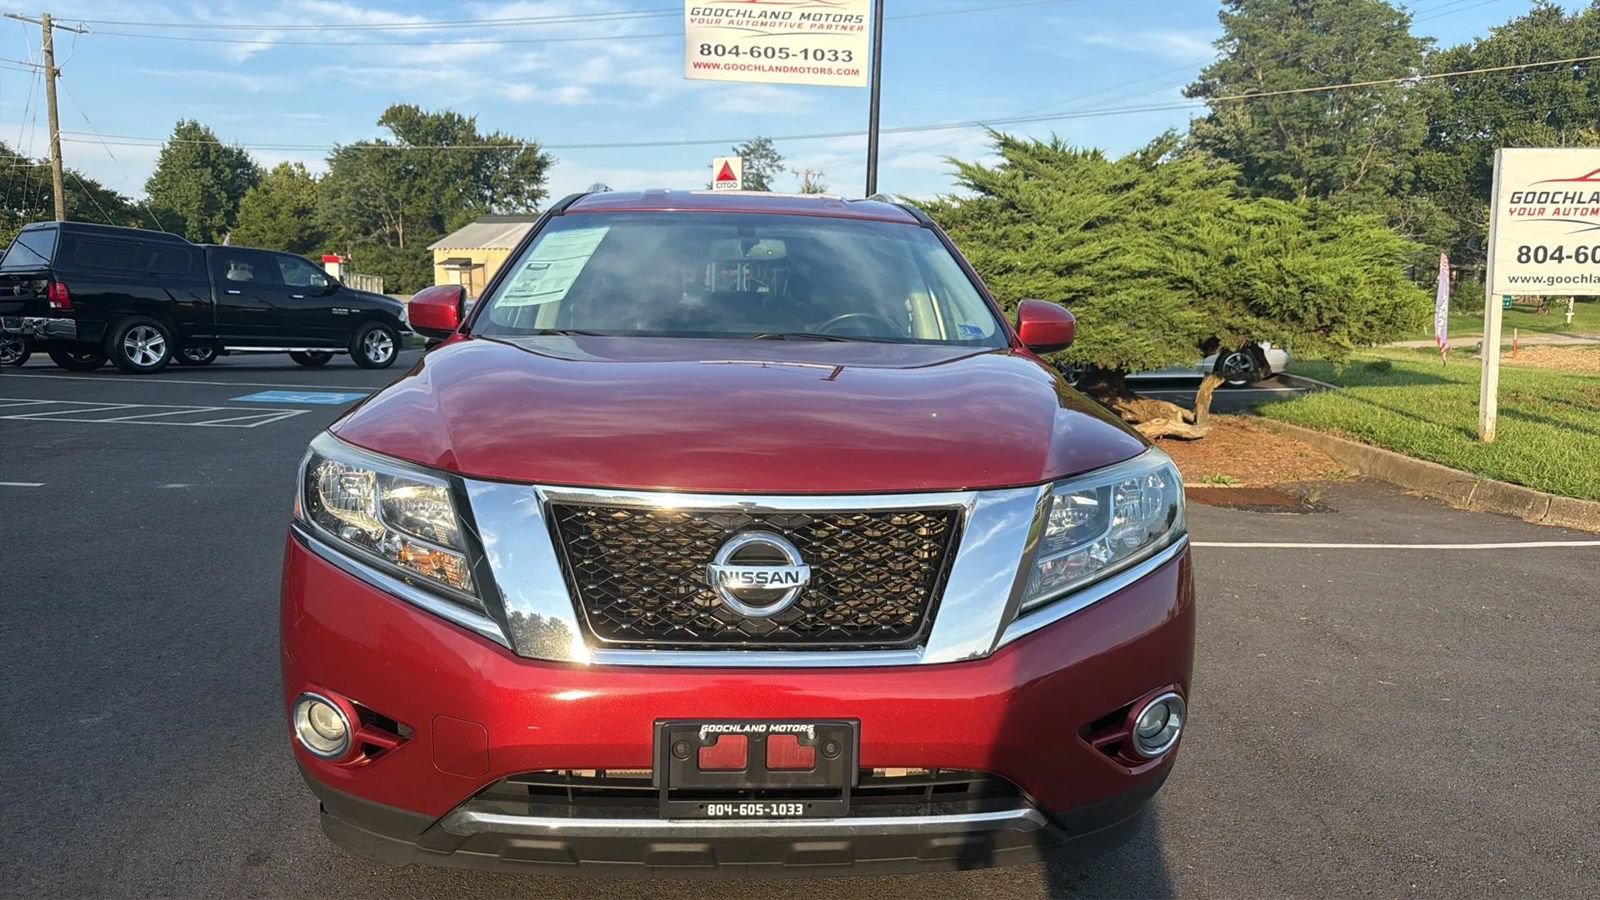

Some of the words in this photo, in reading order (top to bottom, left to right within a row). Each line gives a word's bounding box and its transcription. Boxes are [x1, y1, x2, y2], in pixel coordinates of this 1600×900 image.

[690, 7, 793, 21] GOOCHLAND
[799, 12, 865, 24] MOTORS
[690, 17, 722, 25] YOUR
[727, 19, 804, 29] AUTOMOTIVE
[809, 23, 864, 31] PARTNER
[699, 43, 853, 63] 804-605-1033
[692, 62, 860, 76] WWW.GOOCHLANDMOTORS.COM
[1509, 191, 1600, 204] GOOCHLA
[1509, 207, 1546, 217] YOUR
[1552, 207, 1600, 217] AUTOM
[718, 570, 799, 584] NISSAN
[700, 724, 767, 733] GOOCHLAND
[769, 724, 815, 733] MOTORS
[707, 803, 804, 816] 804-605-1033
